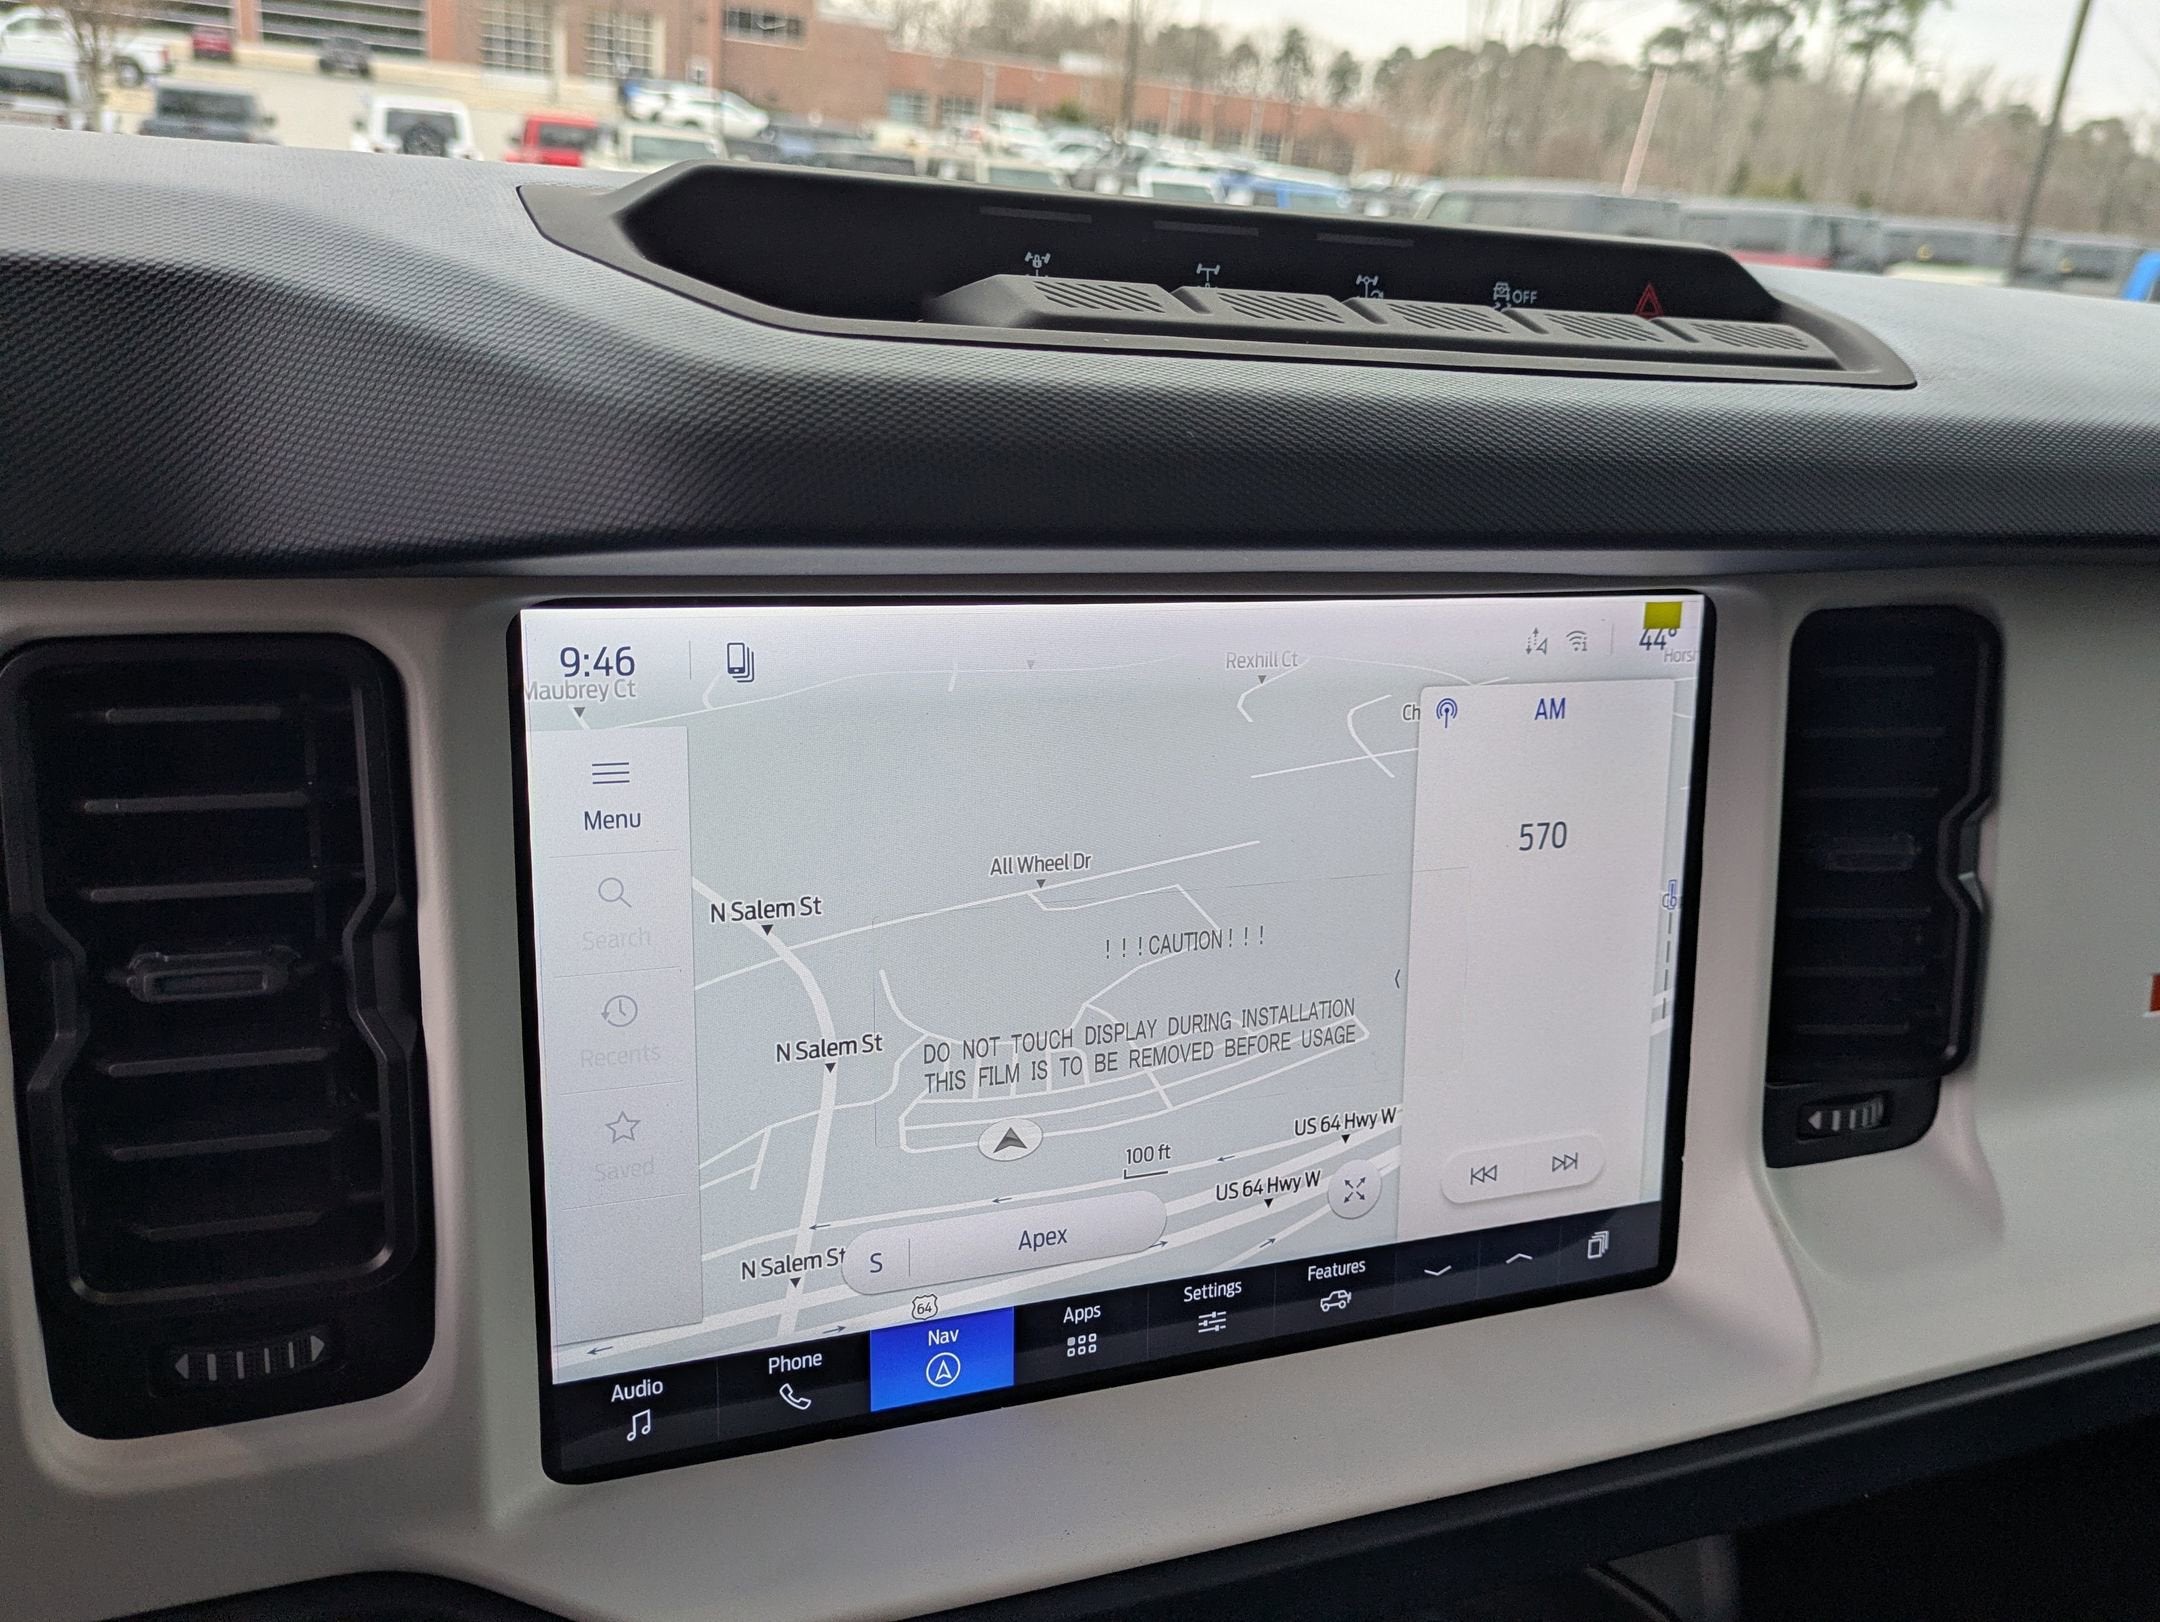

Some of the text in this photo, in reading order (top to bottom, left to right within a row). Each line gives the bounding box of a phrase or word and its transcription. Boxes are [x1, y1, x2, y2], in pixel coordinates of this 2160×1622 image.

[1512, 289, 1538, 304] OFF
[560, 646, 636, 678] 9:46
[1226, 650, 1299, 669] Rexhill Ct
[614, 679, 637, 698] Ct
[1534, 698, 1566, 721] AM
[583, 810, 642, 832] Menu
[1518, 821, 1568, 852] 570
[990, 854, 1092, 875] All Wheel Dr
[710, 896, 822, 923] N Salem St
[582, 928, 651, 950] Search
[923, 998, 1356, 1065] DO NOT TOUCH DISPLAY DURING INSTALLATION
[580, 1044, 662, 1069] Recents
[776, 1034, 883, 1062] N Salem St
[924, 1024, 1357, 1094] THIS FILM IS TO BE REMOVED BEFORE USAGE
[1294, 1107, 1398, 1137] US 64 Hwy W
[1125, 1144, 1172, 1166] 100 ft
[594, 1157, 656, 1182] Saved
[1216, 1170, 1322, 1202] US 64 Hwy W
[1018, 1226, 1068, 1252] Apex
[741, 1246, 846, 1281] N Salem St
[869, 1253, 884, 1274] S
[1307, 1258, 1367, 1281] Features
[1183, 1280, 1243, 1303] Settings
[916, 1302, 933, 1316] 64
[1063, 1306, 1102, 1326] Apps
[927, 1328, 960, 1347] Nav
[768, 1351, 823, 1374] Phone
[611, 1378, 664, 1402] Audio
